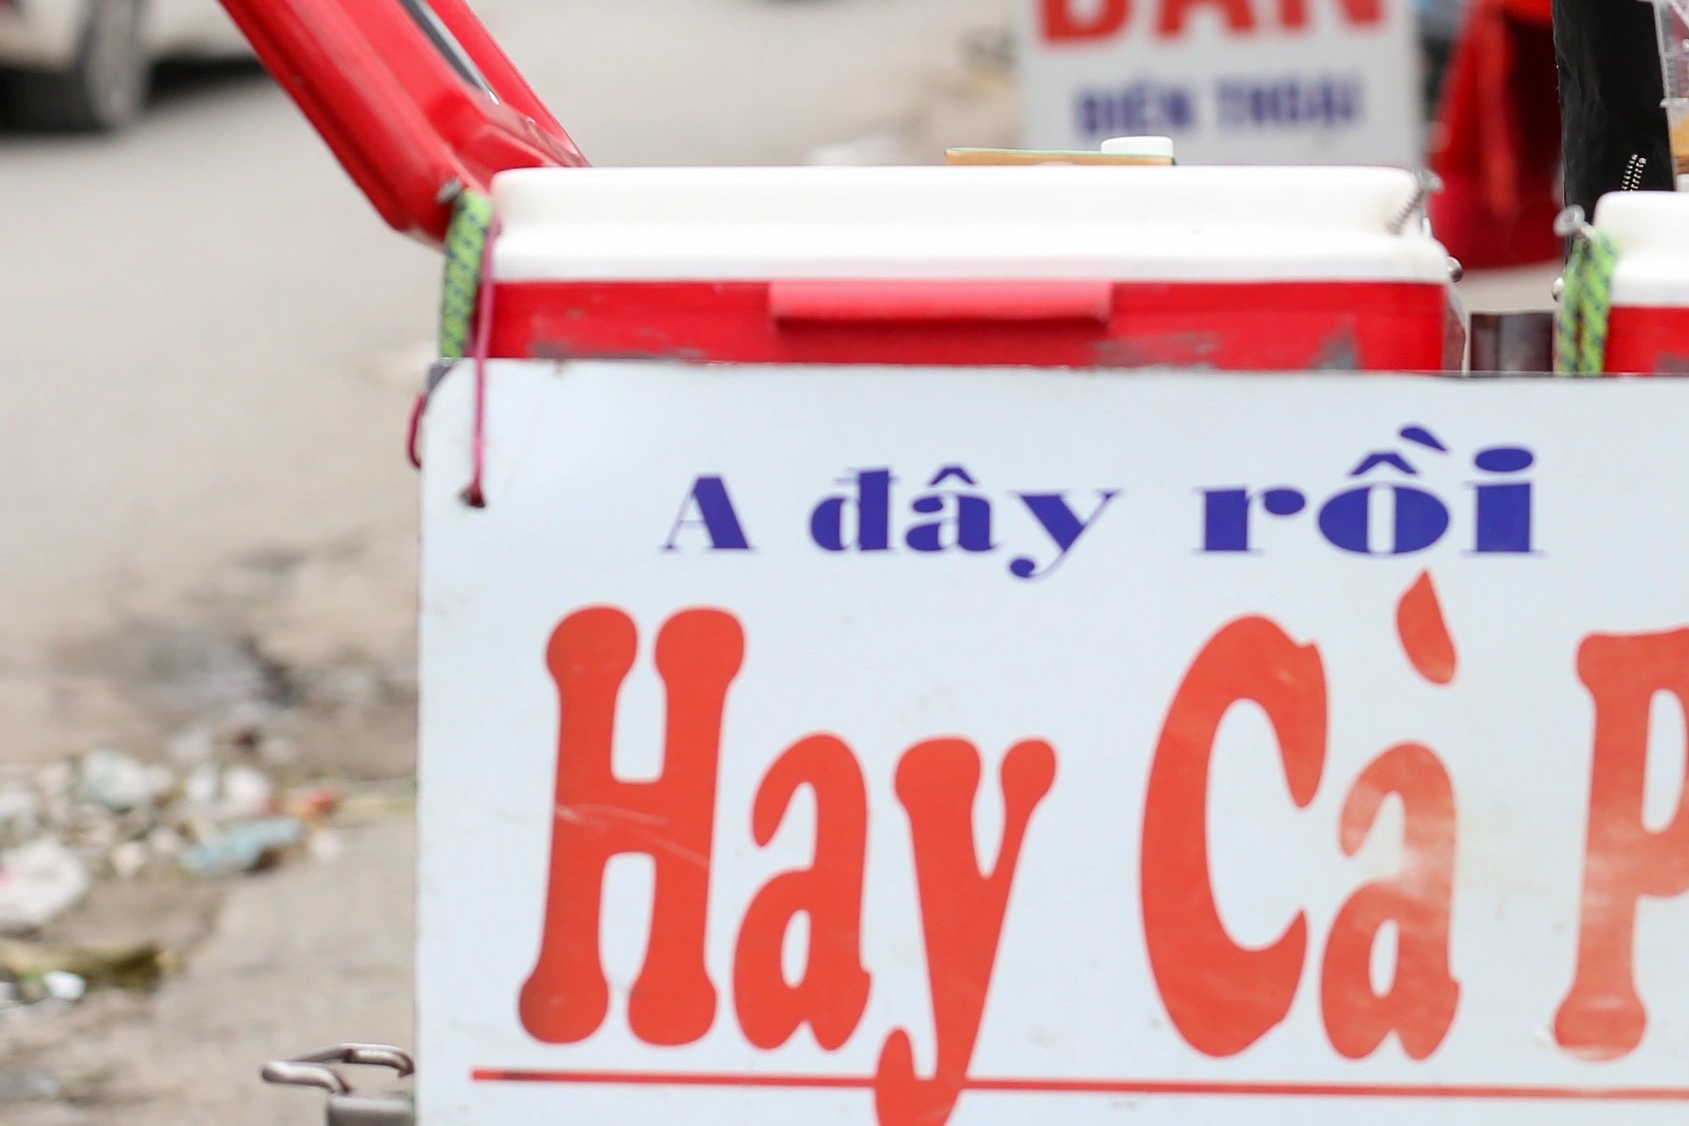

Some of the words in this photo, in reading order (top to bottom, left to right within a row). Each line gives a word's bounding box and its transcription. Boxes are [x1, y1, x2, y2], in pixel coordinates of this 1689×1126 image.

[662, 474, 757, 554] A
[809, 464, 1123, 581] đây
[1193, 423, 1546, 559] rồi
[517, 605, 1058, 1126] Hay
[1139, 569, 1462, 1062] Cà
